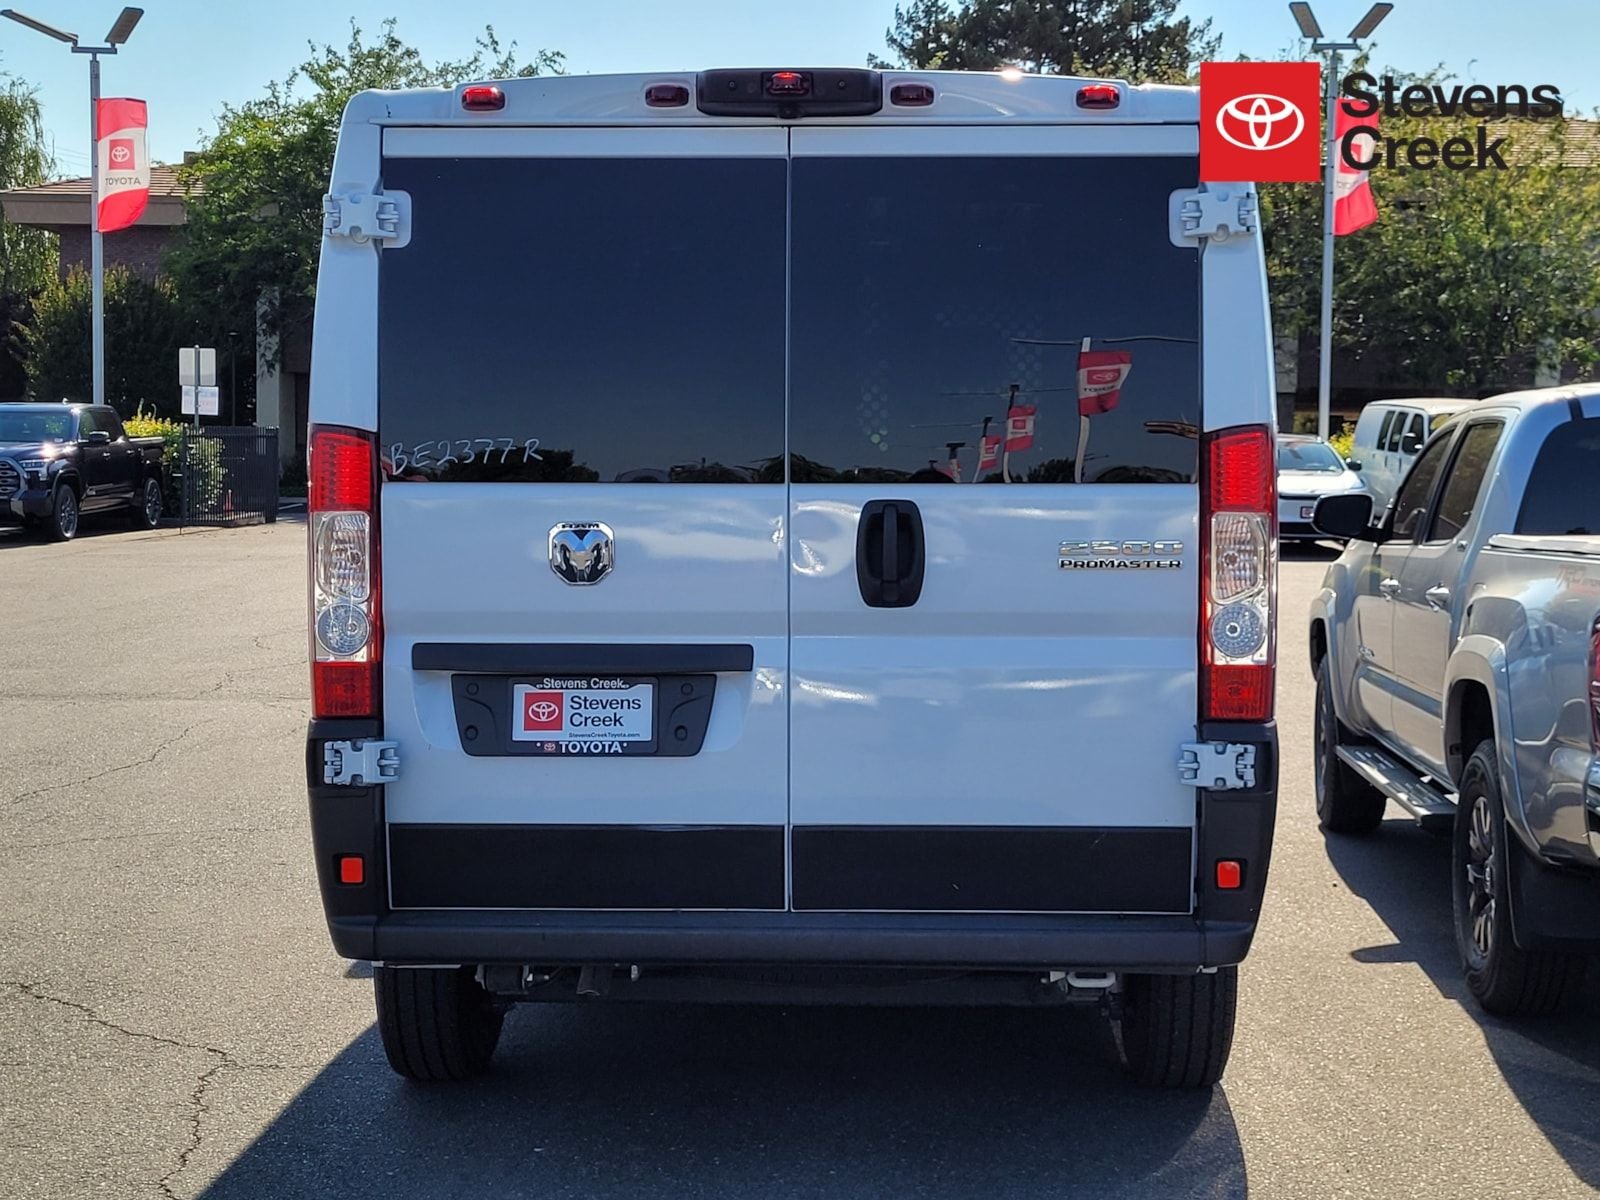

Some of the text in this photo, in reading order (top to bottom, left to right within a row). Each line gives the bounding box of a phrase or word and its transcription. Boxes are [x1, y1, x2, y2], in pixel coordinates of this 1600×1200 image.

[105, 177, 141, 186] TOYOTA
[390, 438, 544, 476] BE2377R
[1059, 540, 1183, 556] 2500
[543, 677, 625, 689] Stevens Creek
[569, 695, 642, 711] Stevens
[569, 712, 624, 728] Creek
[559, 741, 623, 753] TOYOTA
